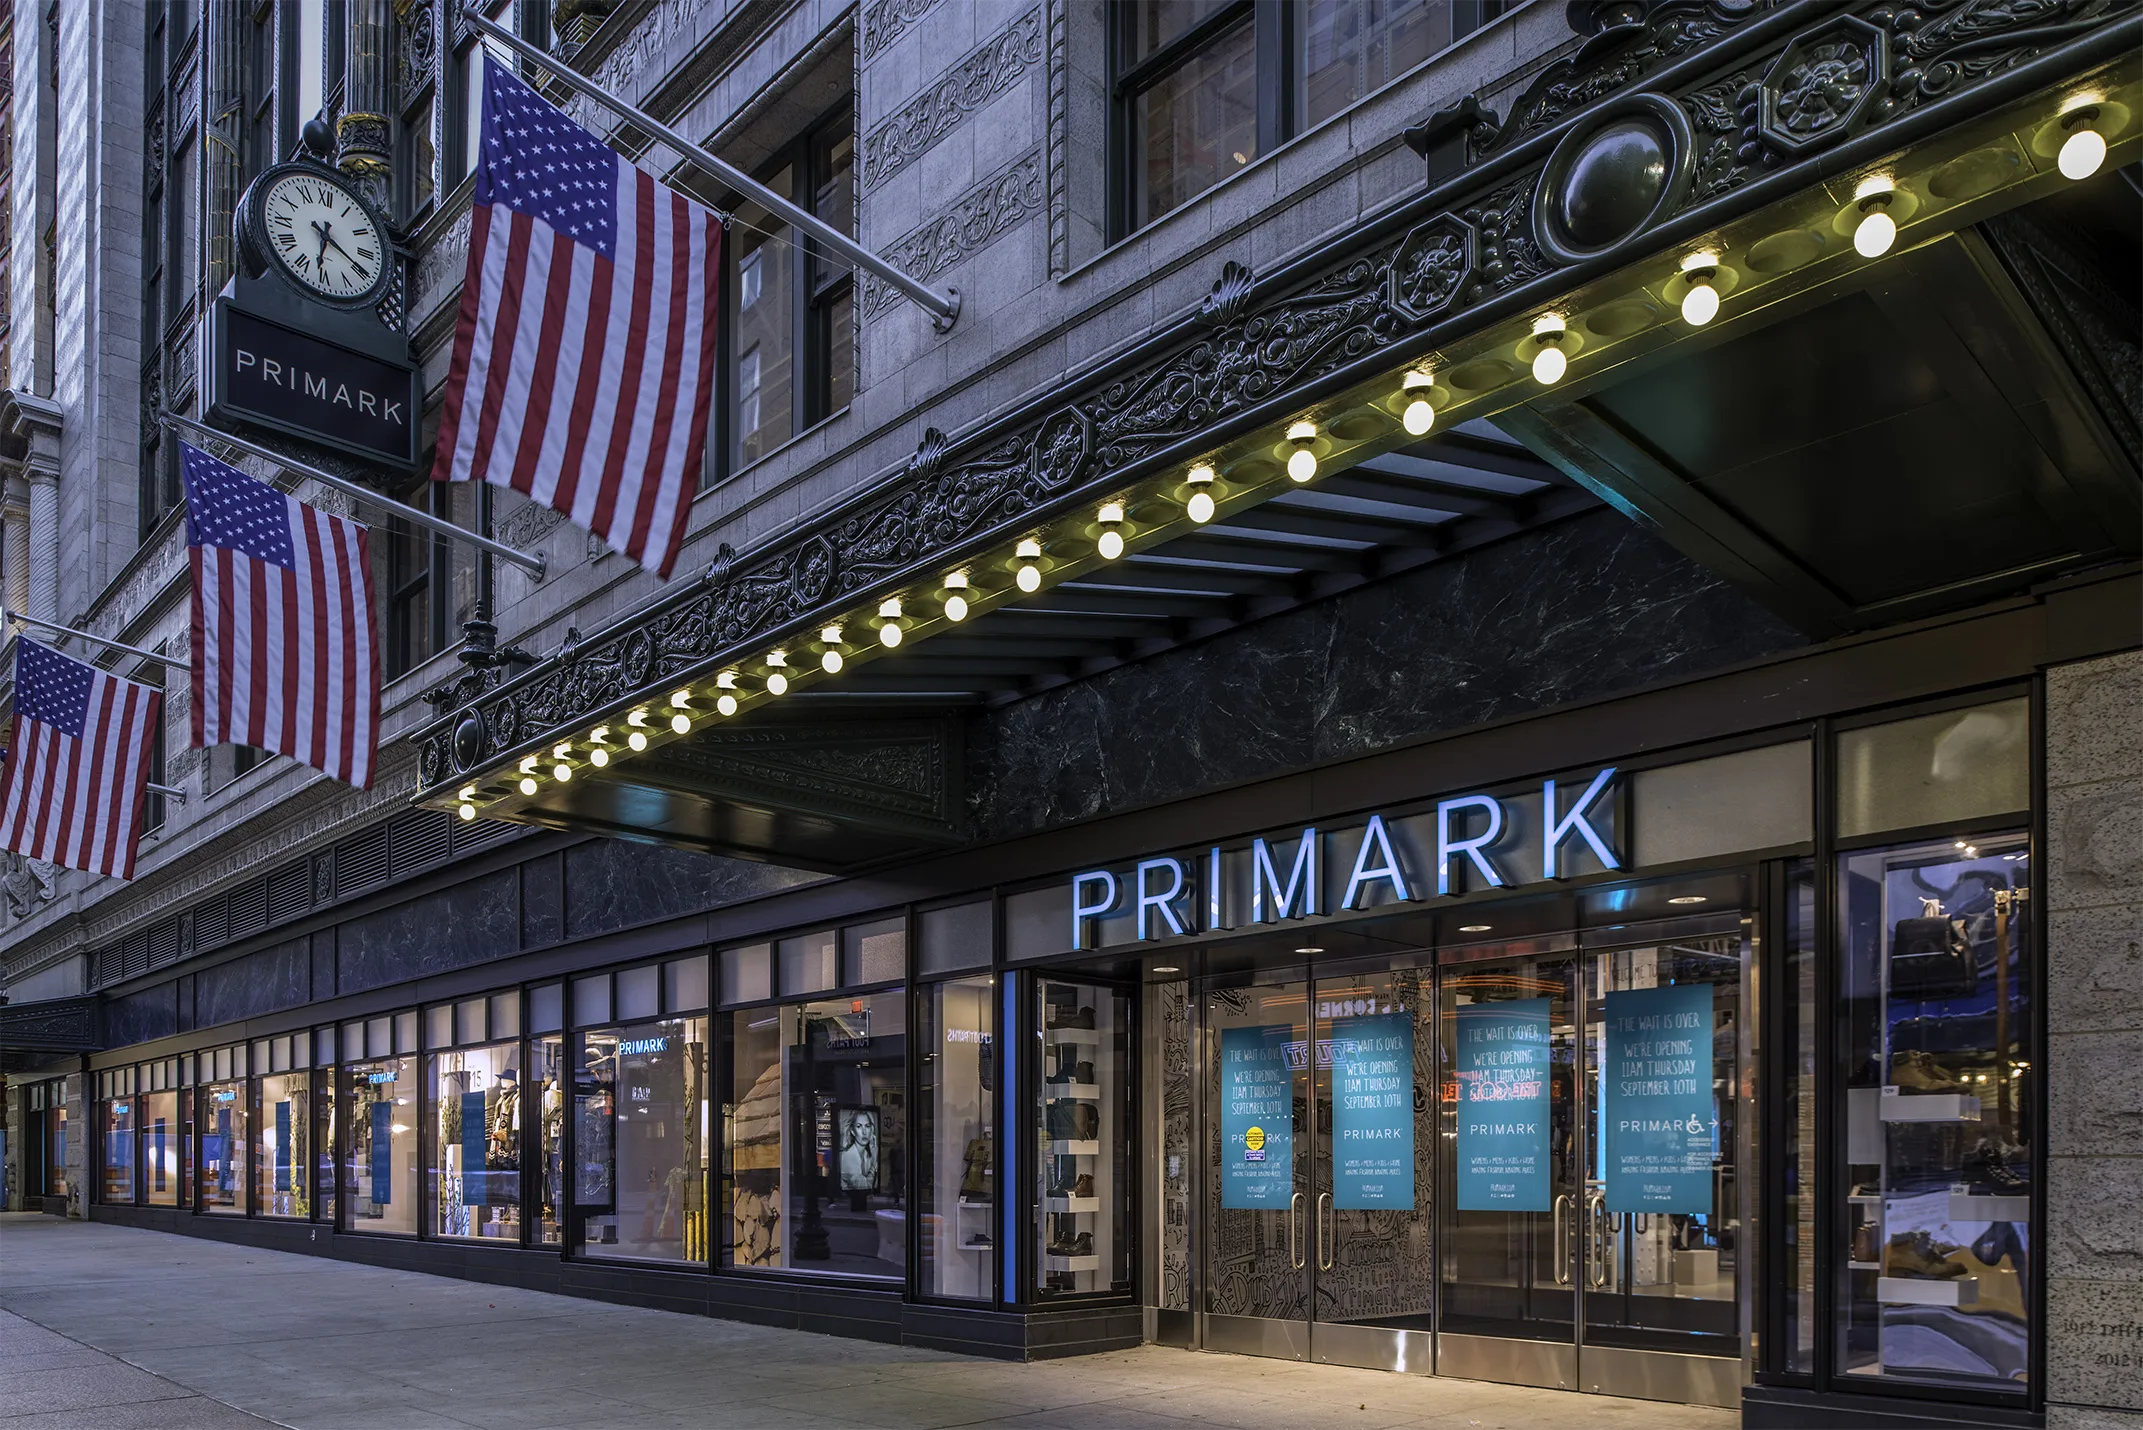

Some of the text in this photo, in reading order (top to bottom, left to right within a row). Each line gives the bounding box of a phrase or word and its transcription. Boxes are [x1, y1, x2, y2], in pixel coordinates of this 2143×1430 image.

[236, 349, 402, 425] PRIMARK
[1073, 767, 1622, 950] PRIMARK
[1618, 1012, 1700, 1032] THE WAIT IS OVER
[1468, 1029, 1483, 1043] THE
[1485, 1027, 1504, 1041] WAIT
[1508, 1025, 1515, 1040] IS
[1517, 1024, 1539, 1039] OVER
[619, 1037, 664, 1056] PRIMARK
[1358, 1039, 1373, 1052] WAIT
[1376, 1038, 1383, 1051] IS
[1385, 1036, 1403, 1051] OVER
[1624, 1039, 1693, 1058] WE'RE OPENING
[1230, 1050, 1242, 1063] THE
[1244, 1049, 1258, 1061] WAIT
[1473, 1051, 1497, 1067] WE'RE
[1500, 1049, 1533, 1064] OPENING
[1234, 1069, 1280, 1083] WE'RE OPENING
[1346, 1060, 1398, 1076] WE'RE OPENING
[1493, 1068, 1536, 1082] THURSDAY
[1622, 1060, 1696, 1078] 11AM THURSDAY
[1232, 1085, 1282, 1100] 11AM THURSDAY
[1345, 1077, 1400, 1092] 11AM THURSDAY
[1620, 1079, 1697, 1097] SEPTEMBER 10TH
[1232, 1101, 1282, 1115] SEPTEMBER 10TH
[1344, 1094, 1401, 1109] SEPTEMBER 10TH
[1344, 1128, 1401, 1140] PRIMARK
[1470, 1123, 1536, 1135] PRIMARK
[1231, 1133, 1282, 1144] PRRK
[1337, 1277, 1427, 1310] Primark.com
